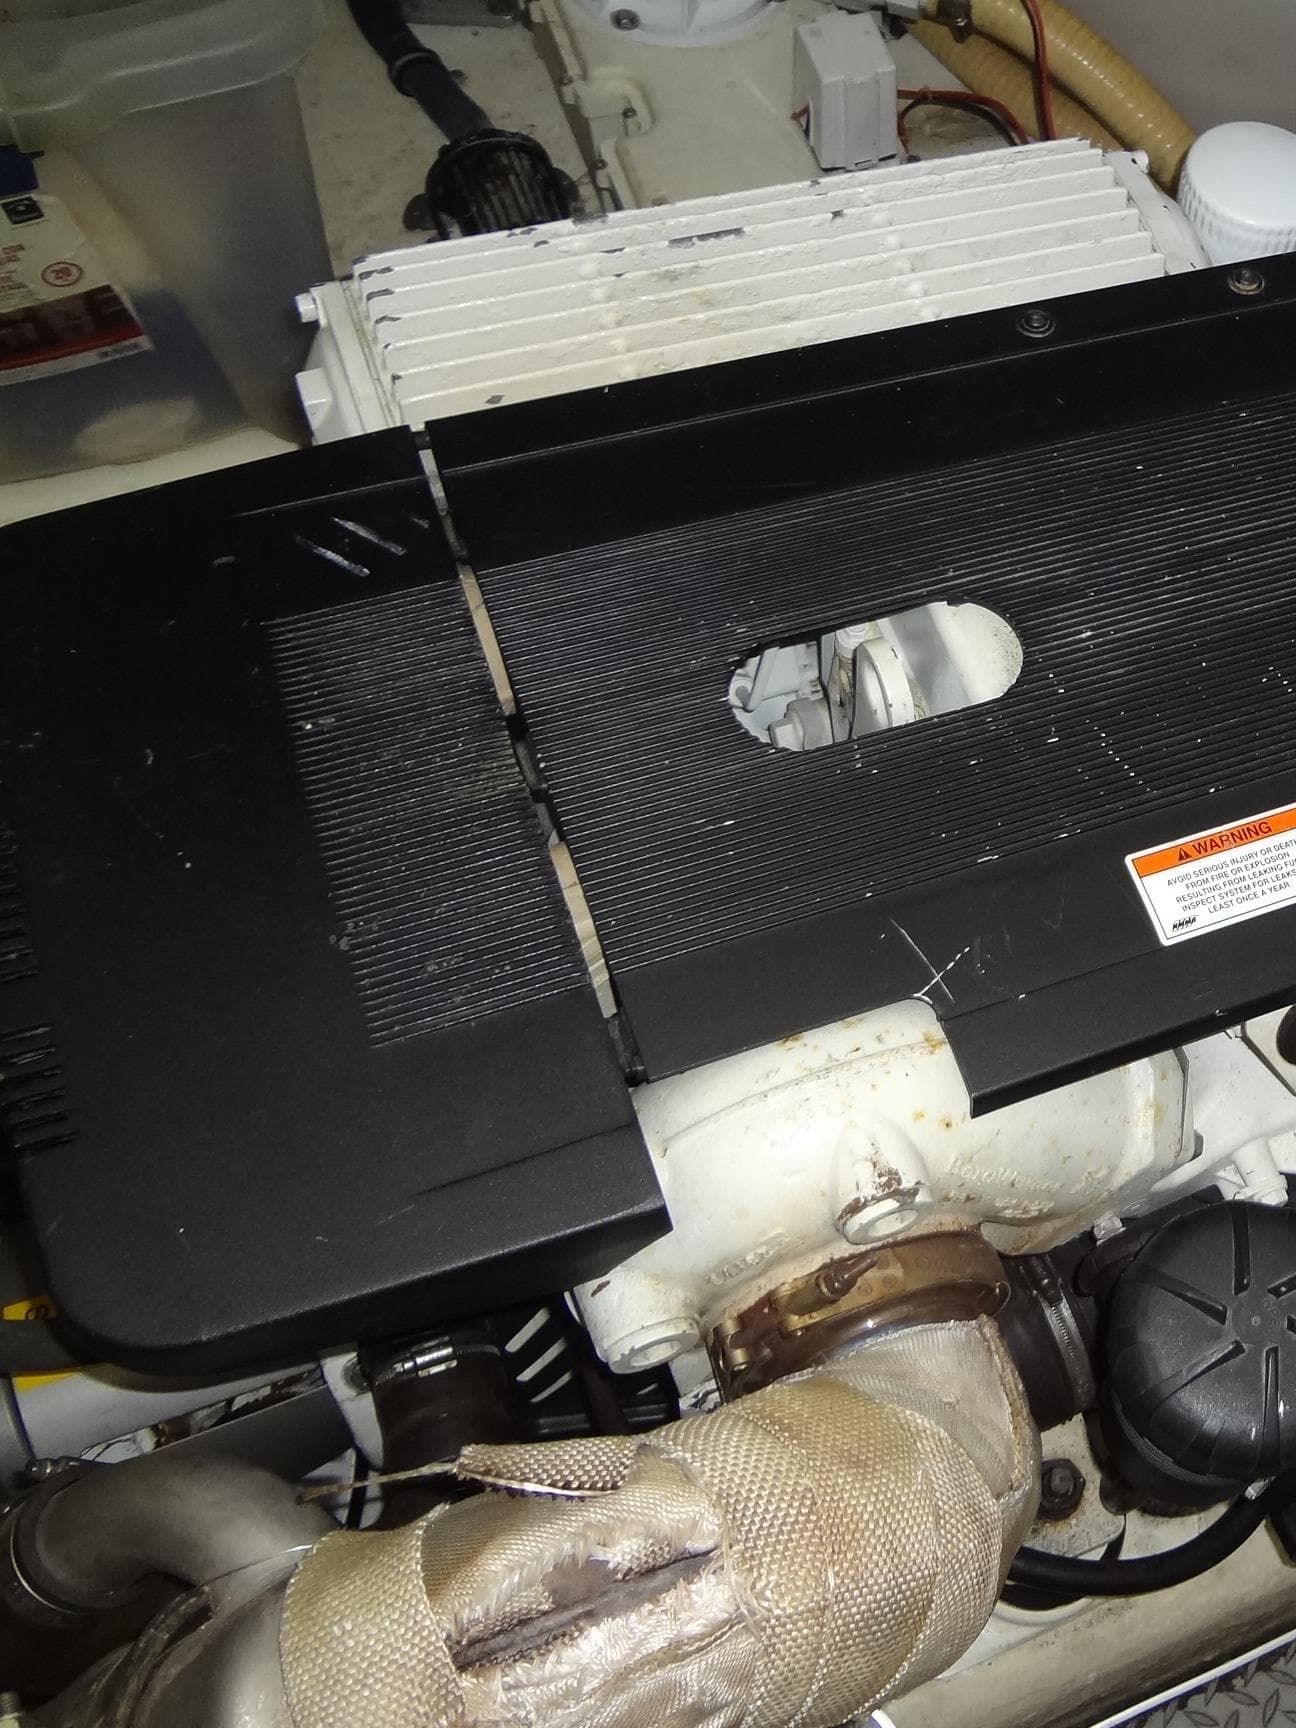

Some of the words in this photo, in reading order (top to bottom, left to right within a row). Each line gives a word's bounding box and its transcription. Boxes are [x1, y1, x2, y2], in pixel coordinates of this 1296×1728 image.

[1192, 821, 1272, 855] WARNING
[1167, 872, 1192, 887] AVOID
[1193, 862, 1229, 879] SERIOUS
[1231, 853, 1260, 870] INJURY
[1260, 848, 1272, 859] OR
[1175, 882, 1222, 904] RESULTING
[1223, 874, 1247, 888] FROM
[1249, 864, 1283, 882] LEAKING
[1186, 876, 1209, 890] FROM
[1211, 870, 1230, 883] FIRE
[1232, 865, 1243, 876] OR
[1244, 852, 1290, 872] EXPLOSION
[1182, 895, 1216, 913] INSPECT
[1218, 884, 1251, 902] SYSTEM
[1253, 878, 1270, 892] FOR
[1208, 900, 1235, 914] LEAST
[1236, 893, 1259, 907] ONCE
[1261, 891, 1267, 899] A
